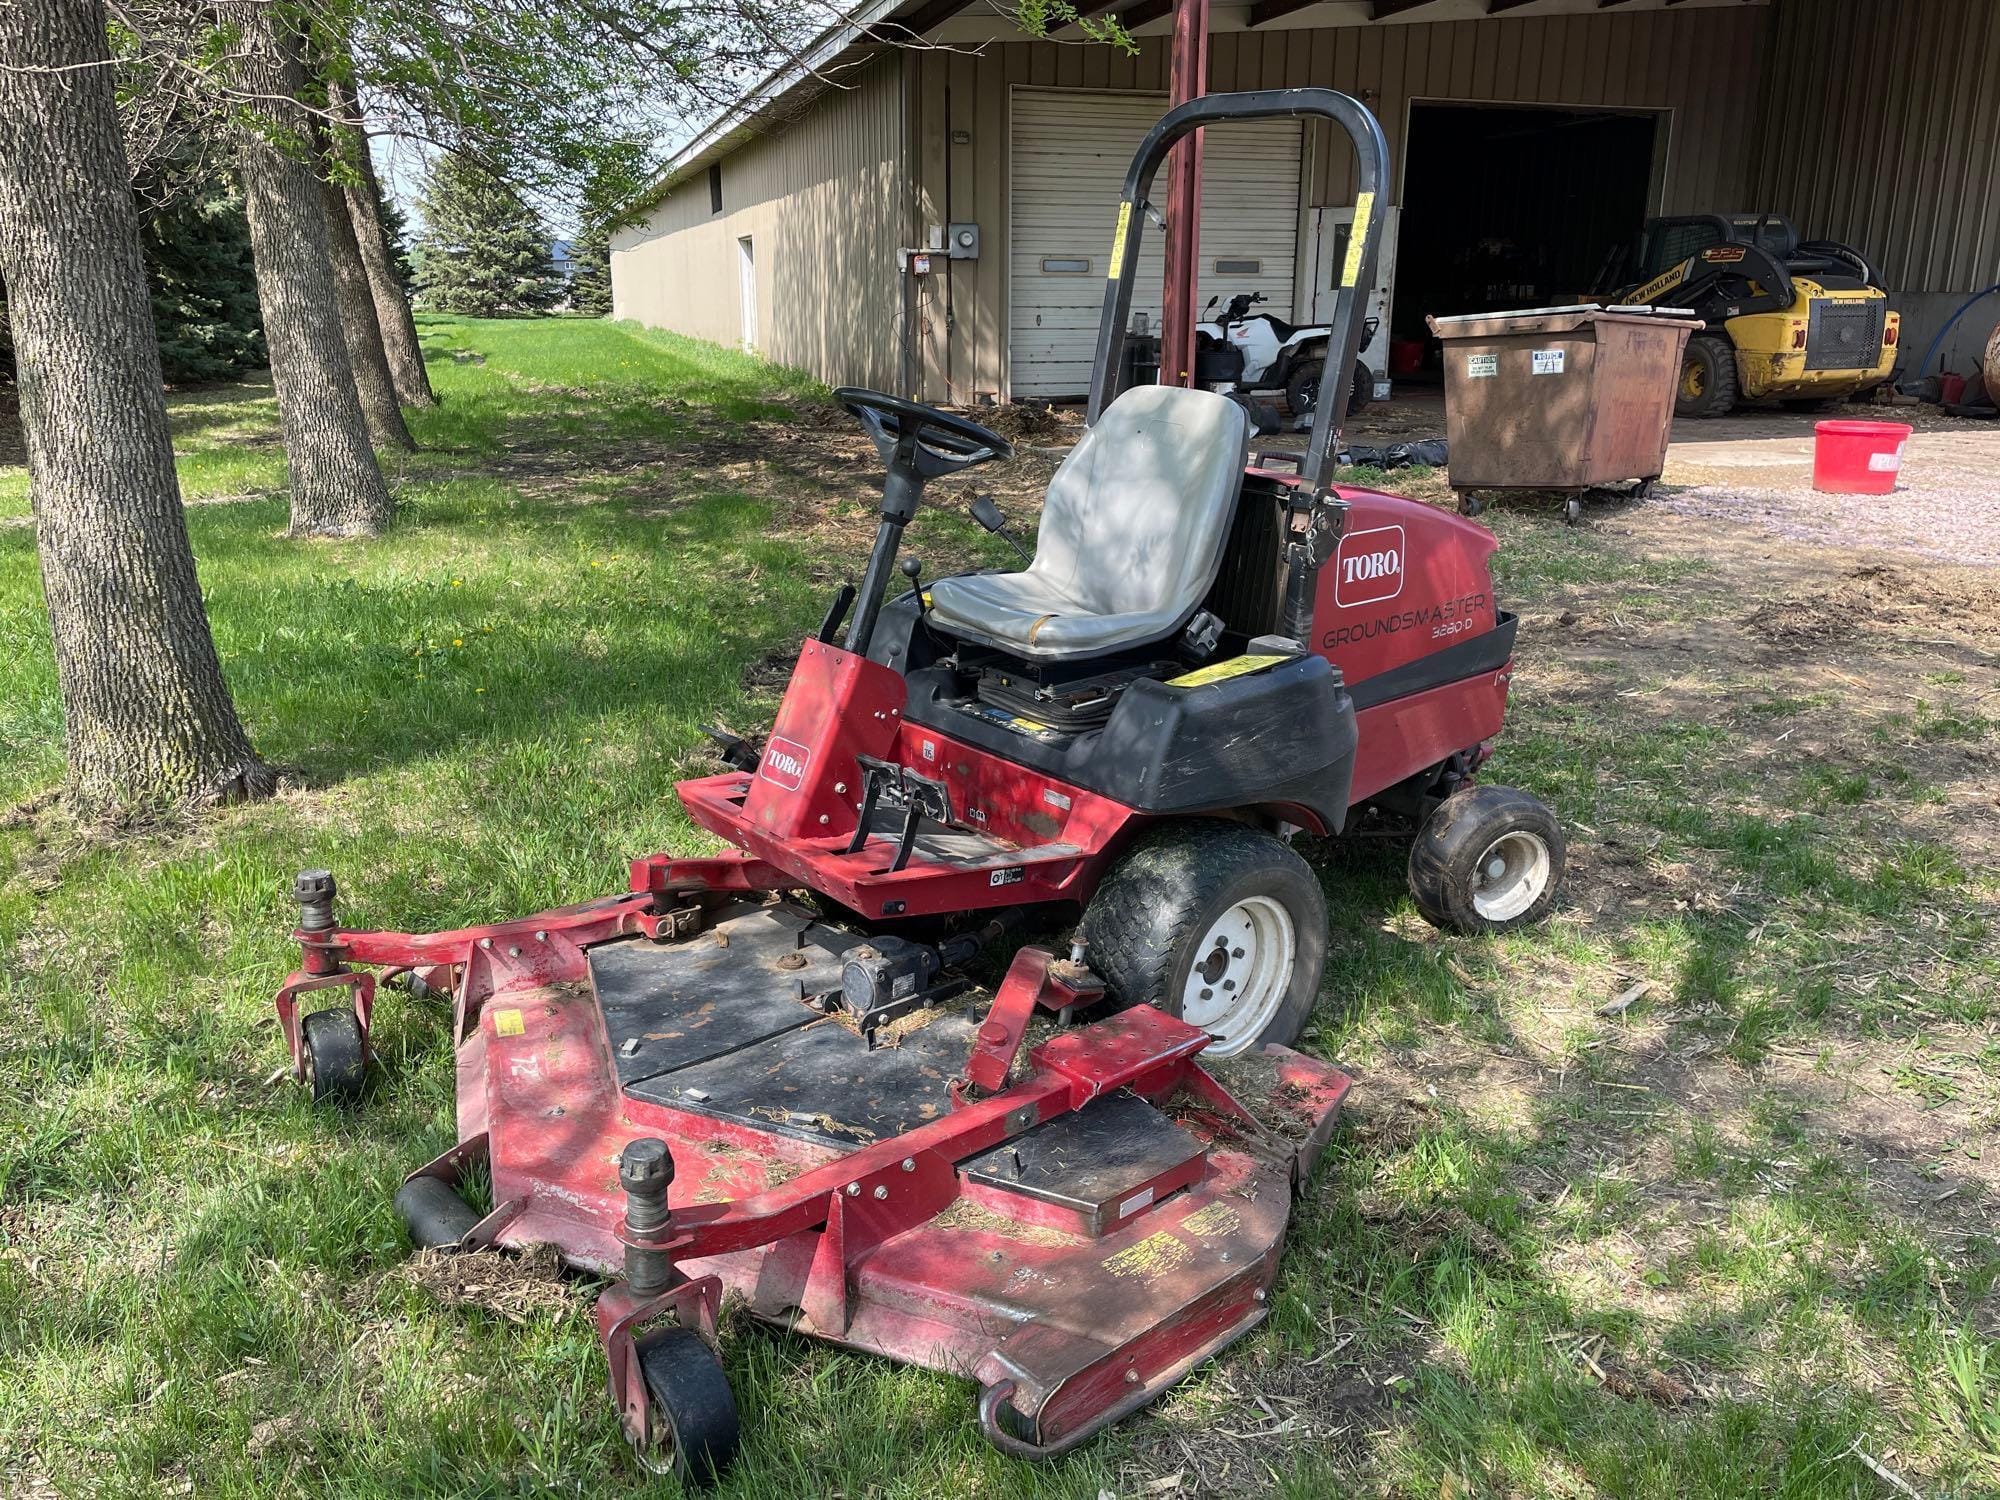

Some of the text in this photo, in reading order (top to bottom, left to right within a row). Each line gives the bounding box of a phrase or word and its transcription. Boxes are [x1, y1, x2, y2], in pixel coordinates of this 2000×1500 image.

[1629, 270, 1681, 304] NEW HOLLAND
[1469, 356, 1496, 364] CAUTION
[1343, 549, 1399, 584] TORO
[1323, 594, 1485, 650] GROUNDSMASTER
[768, 749, 802, 777] TORO
